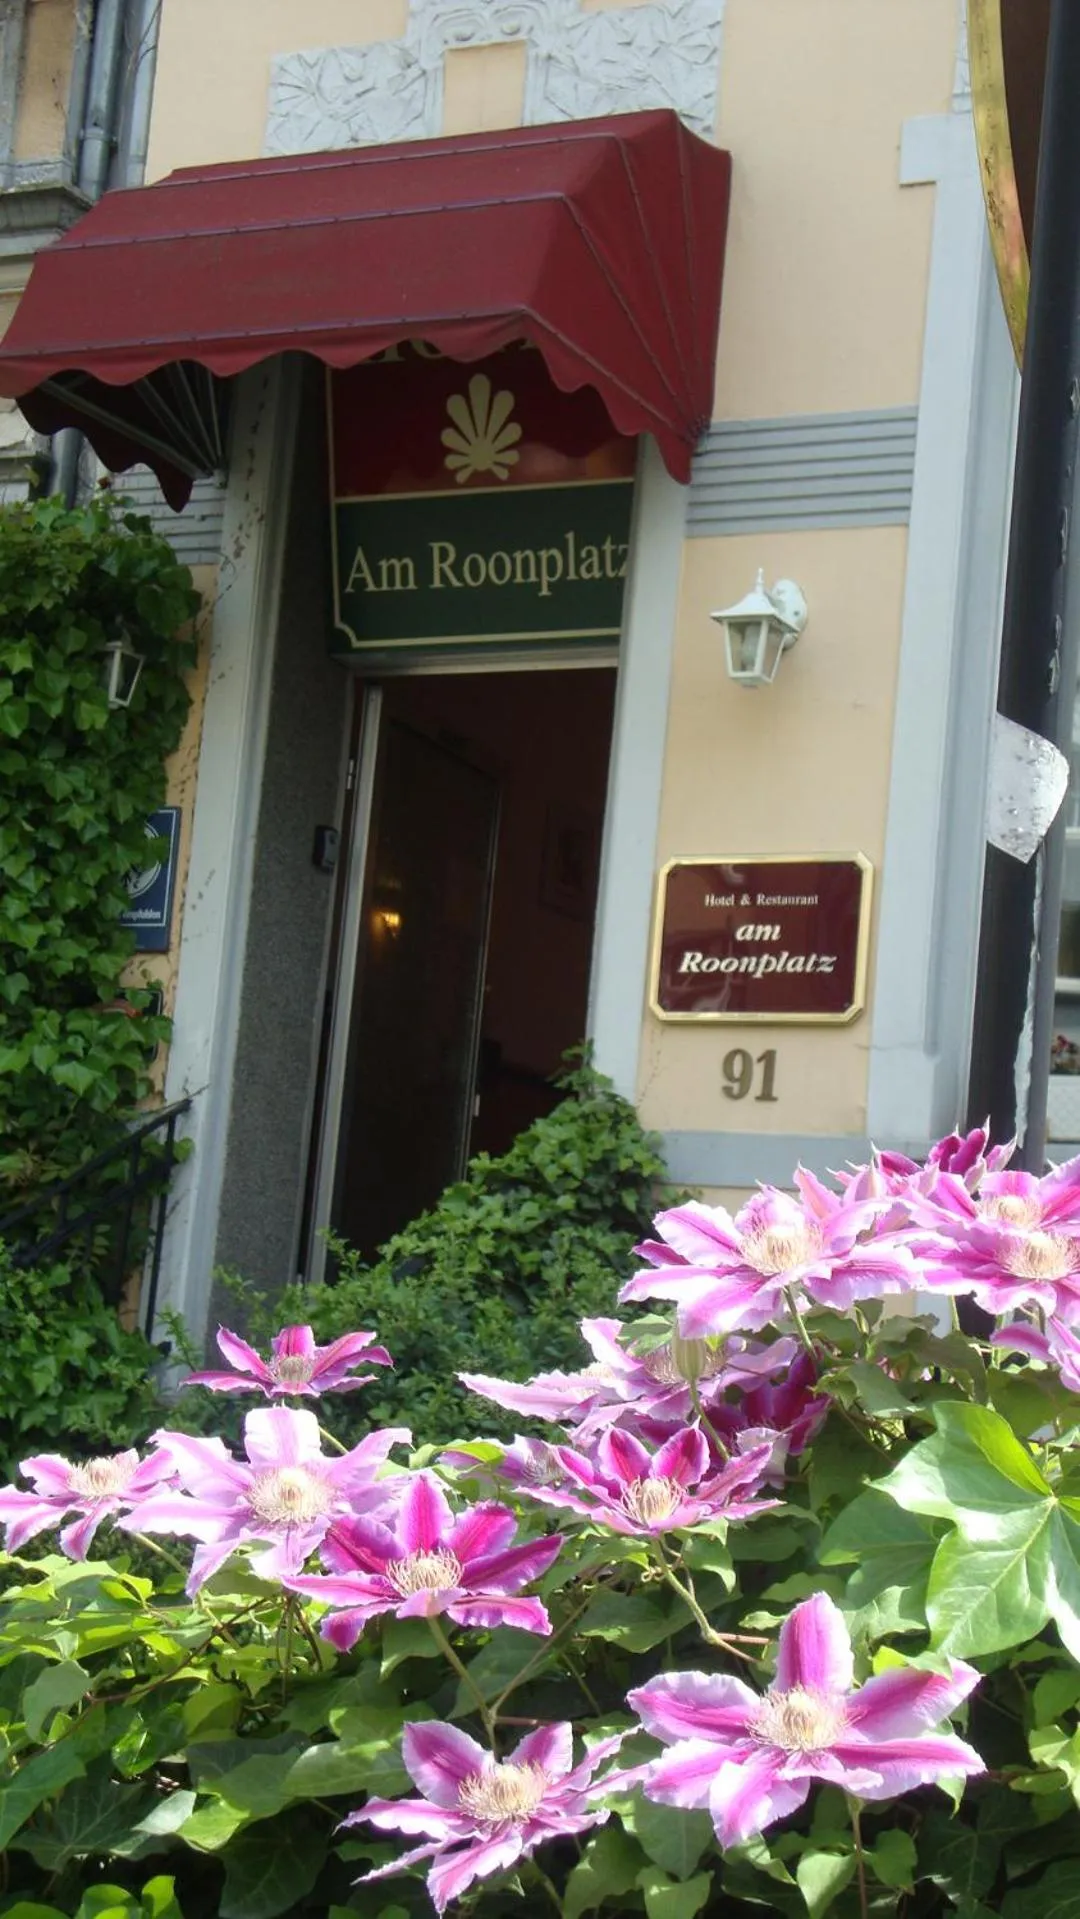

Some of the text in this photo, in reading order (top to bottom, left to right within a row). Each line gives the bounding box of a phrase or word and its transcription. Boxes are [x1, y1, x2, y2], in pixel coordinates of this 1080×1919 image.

[345, 530, 630, 597] Am Roonplatz
[705, 893, 820, 907] Hotel & Restaurant
[735, 923, 781, 942] am
[678, 950, 838, 980] Roonplatz
[721, 1047, 779, 1102] 91
